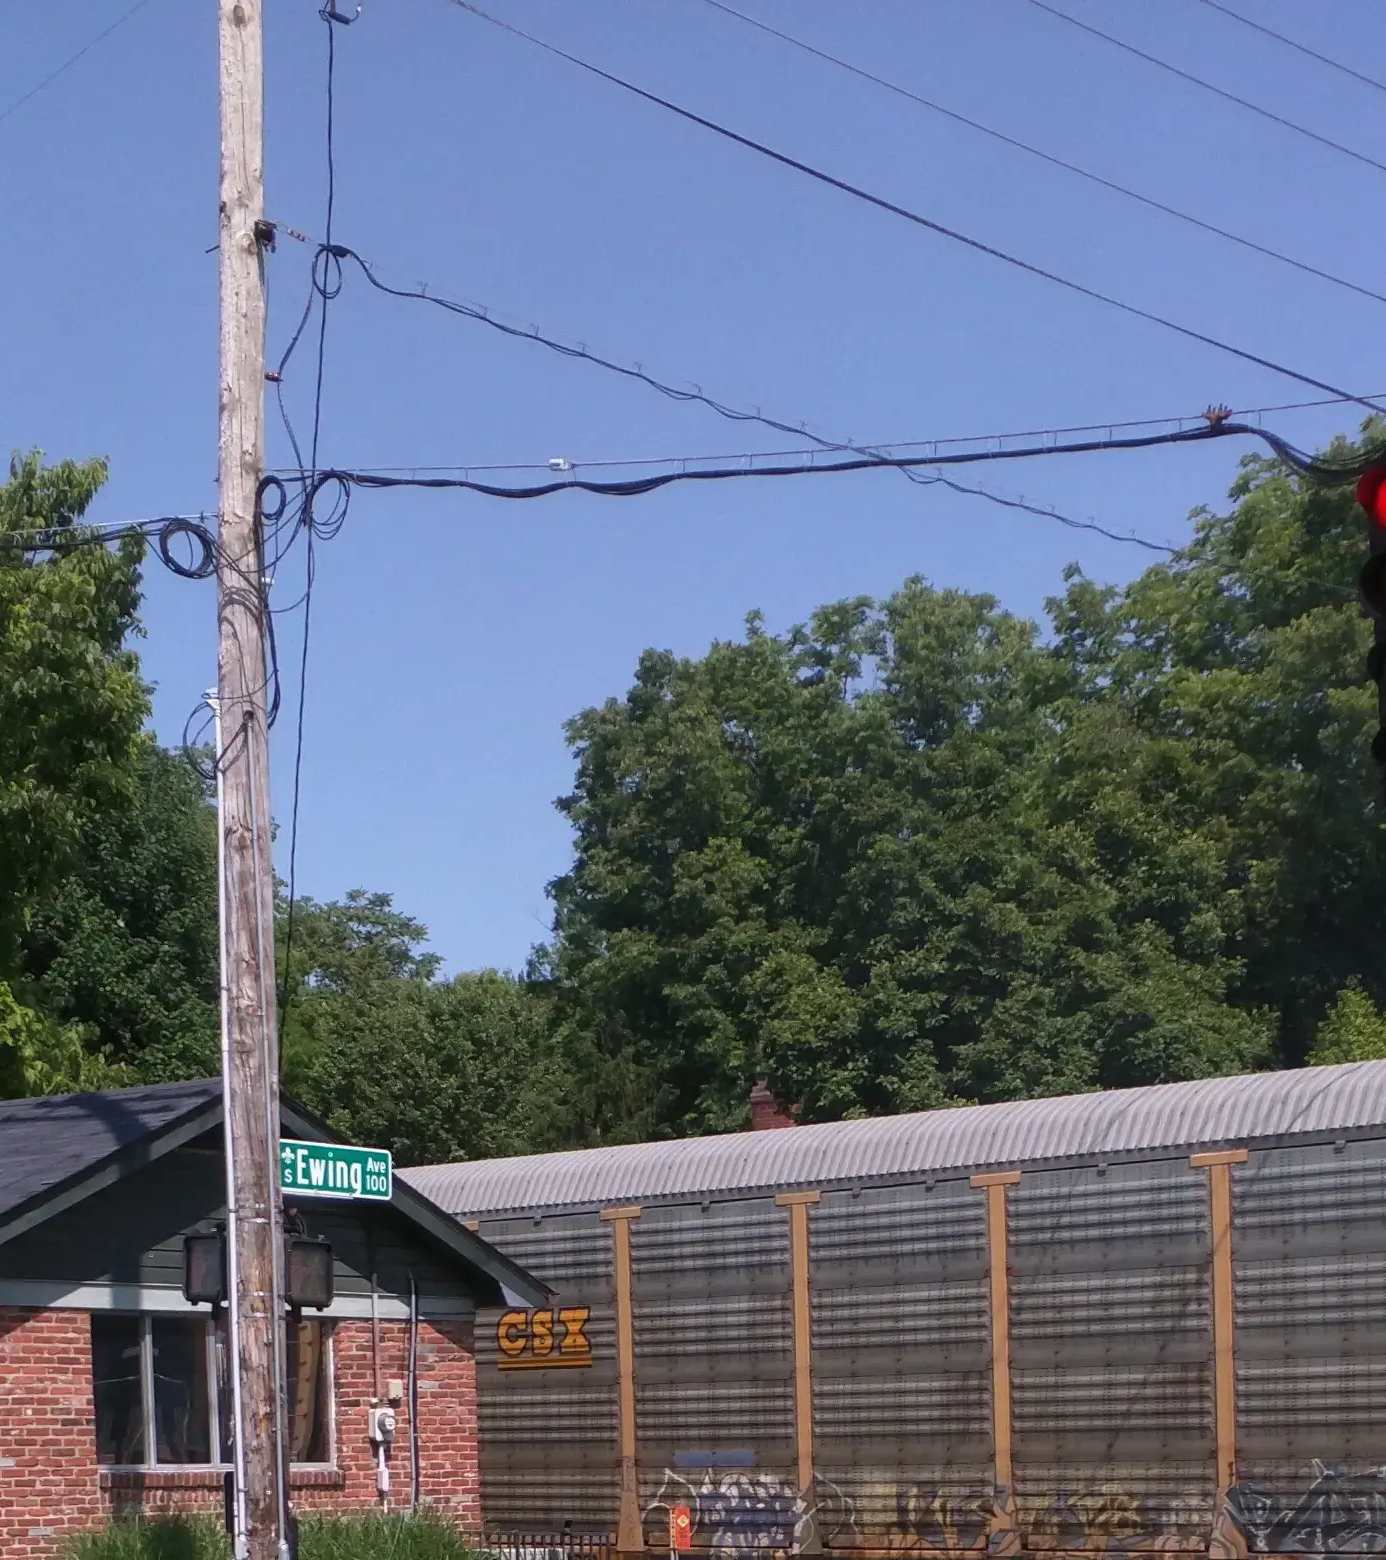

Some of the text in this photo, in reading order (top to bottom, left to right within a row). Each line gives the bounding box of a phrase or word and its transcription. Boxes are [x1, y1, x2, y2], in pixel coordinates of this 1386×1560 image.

[284, 1149, 386, 1195] S Ewing Ave
[366, 1175, 386, 1191] 100
[497, 1306, 591, 1356] CSX
